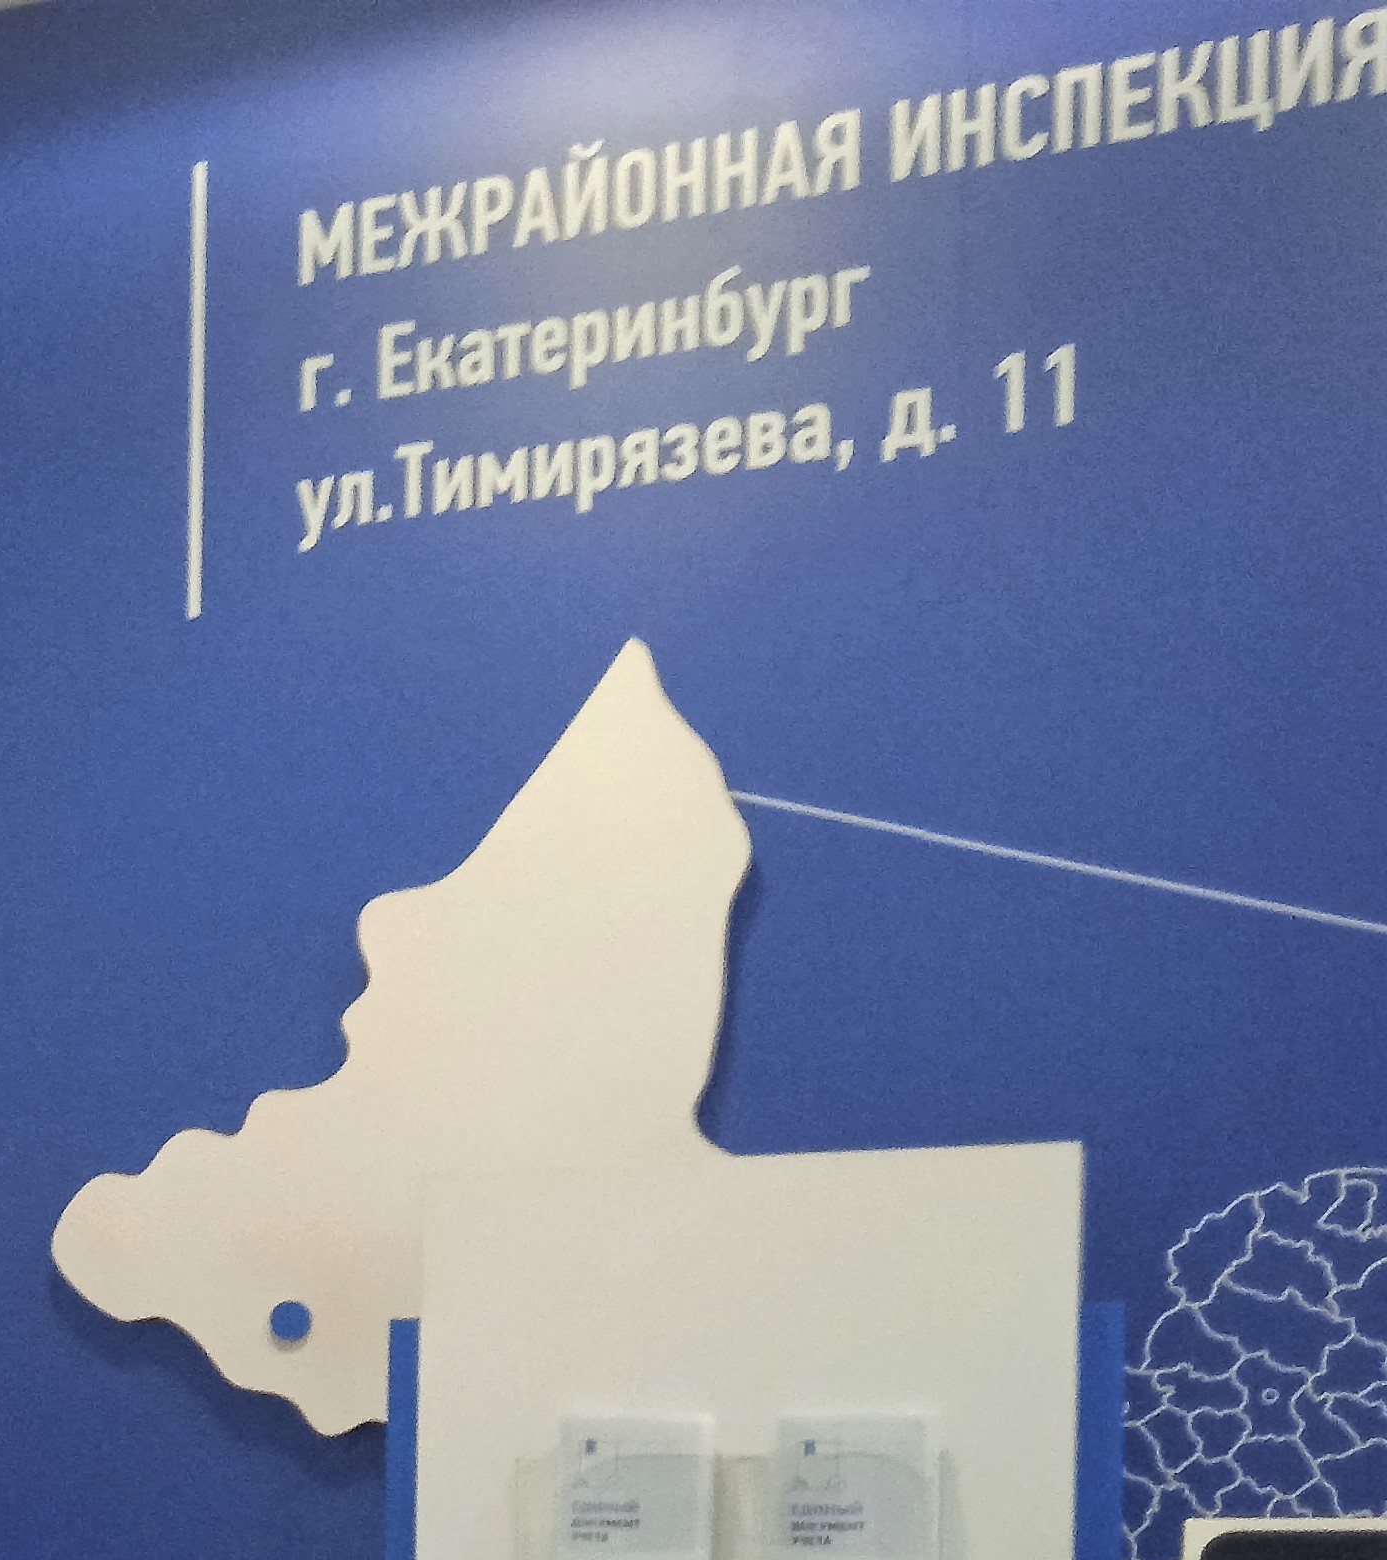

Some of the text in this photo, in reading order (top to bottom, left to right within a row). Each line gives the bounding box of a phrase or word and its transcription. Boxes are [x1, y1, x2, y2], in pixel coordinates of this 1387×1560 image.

[297, 7, 1387, 287] МЕЖРАЙОННАЯ ИНСПЕКЦИЯ
[299, 261, 871, 412] г. Екатеринбург
[296, 343, 1076, 553] ул.Тимирязева, д. 11
